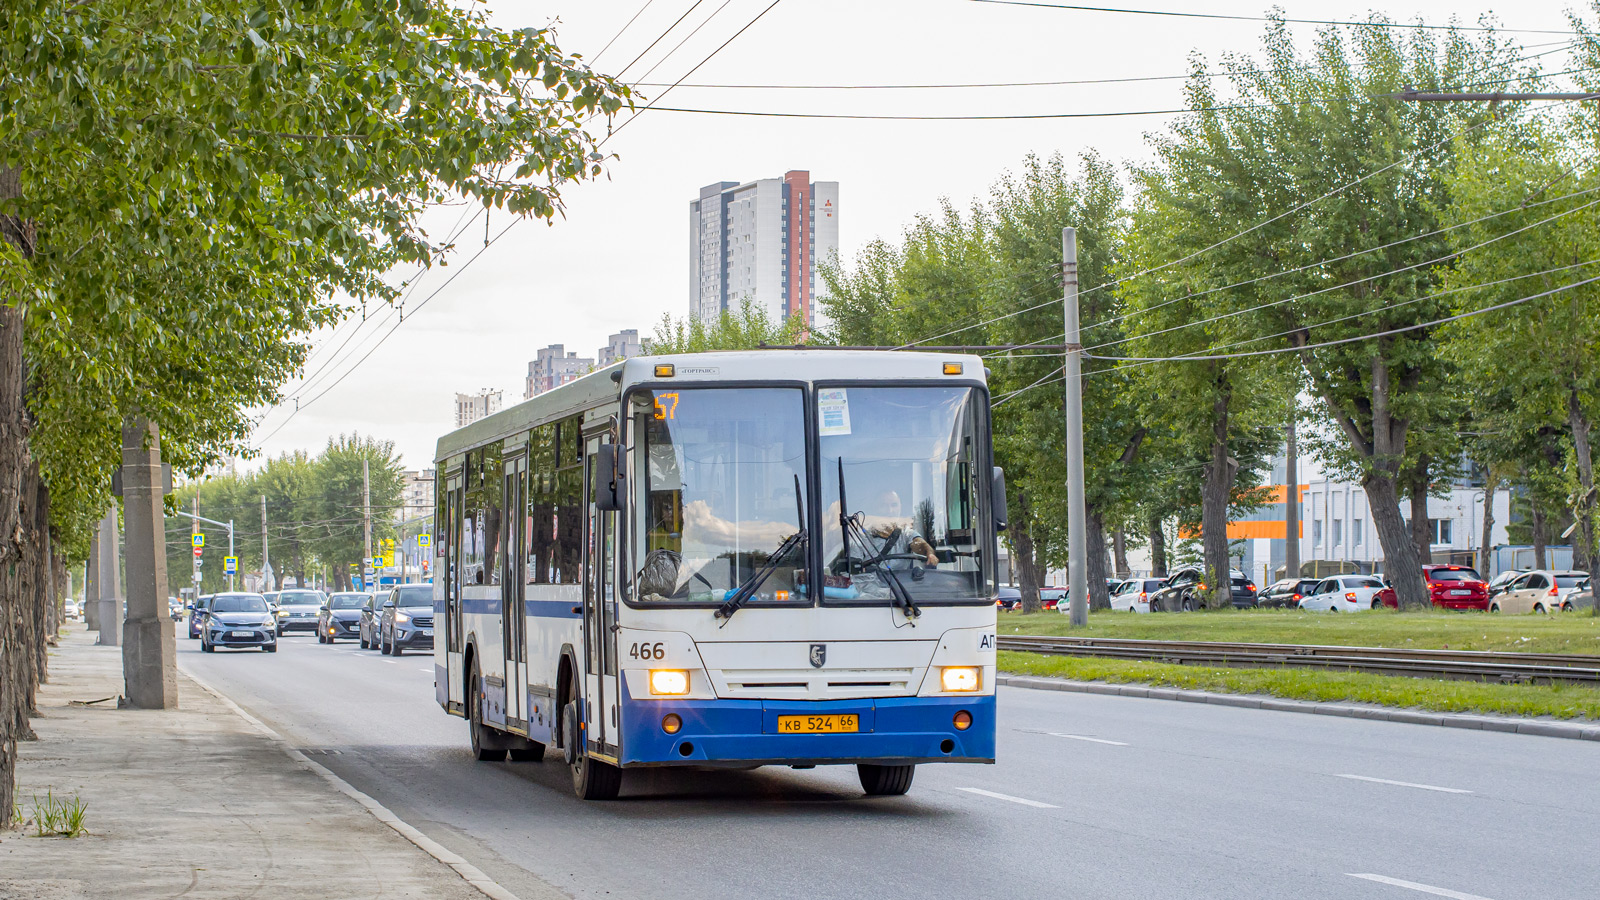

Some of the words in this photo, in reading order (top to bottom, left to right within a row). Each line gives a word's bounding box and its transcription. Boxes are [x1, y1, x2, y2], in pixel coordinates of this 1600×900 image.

[654, 392, 680, 420] 57
[629, 642, 665, 660] 466
[785, 720, 801, 731] КВ
[807, 716, 833, 730] 524
[840, 715, 854, 726] 66
